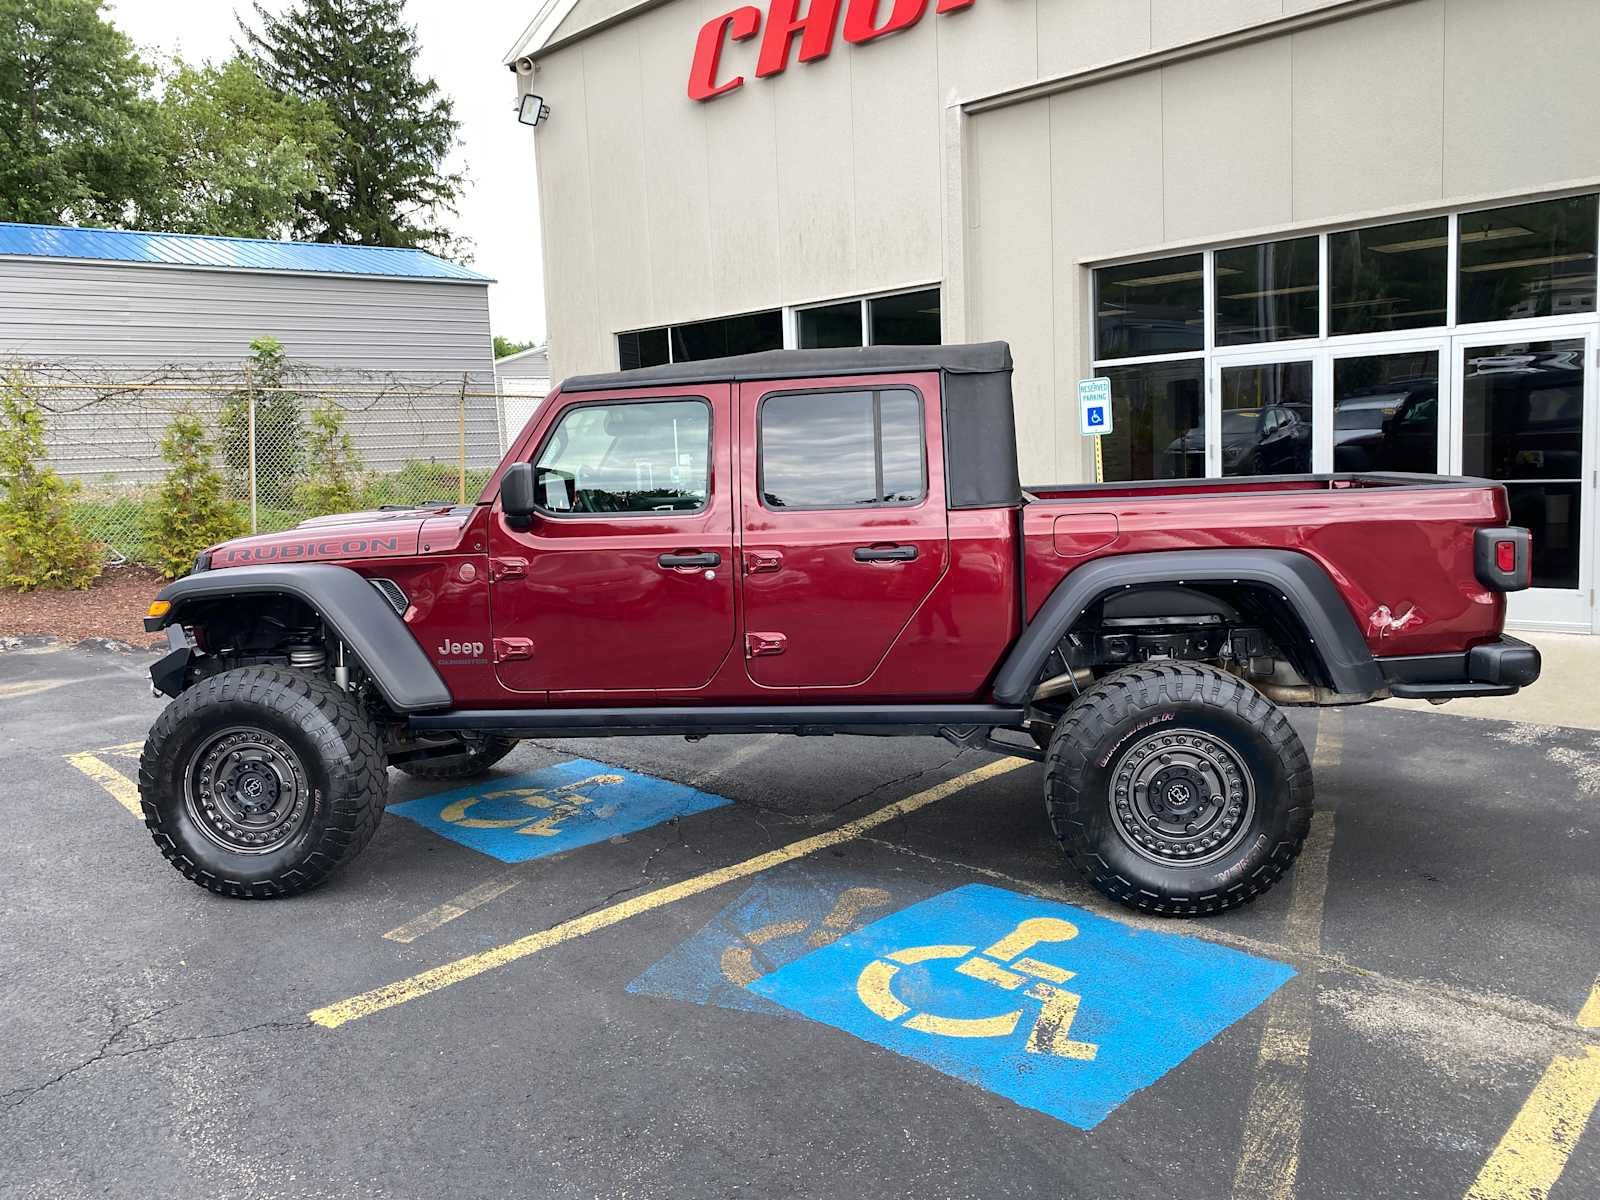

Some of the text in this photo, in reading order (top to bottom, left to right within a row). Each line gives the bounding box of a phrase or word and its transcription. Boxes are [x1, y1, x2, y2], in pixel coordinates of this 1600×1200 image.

[687, 0, 976, 101] CHO
[1080, 383, 1108, 393] RESERVED
[1083, 393, 1107, 401] PARKING
[227, 537, 398, 562] RUBICON
[438, 639, 484, 657] Jeep
